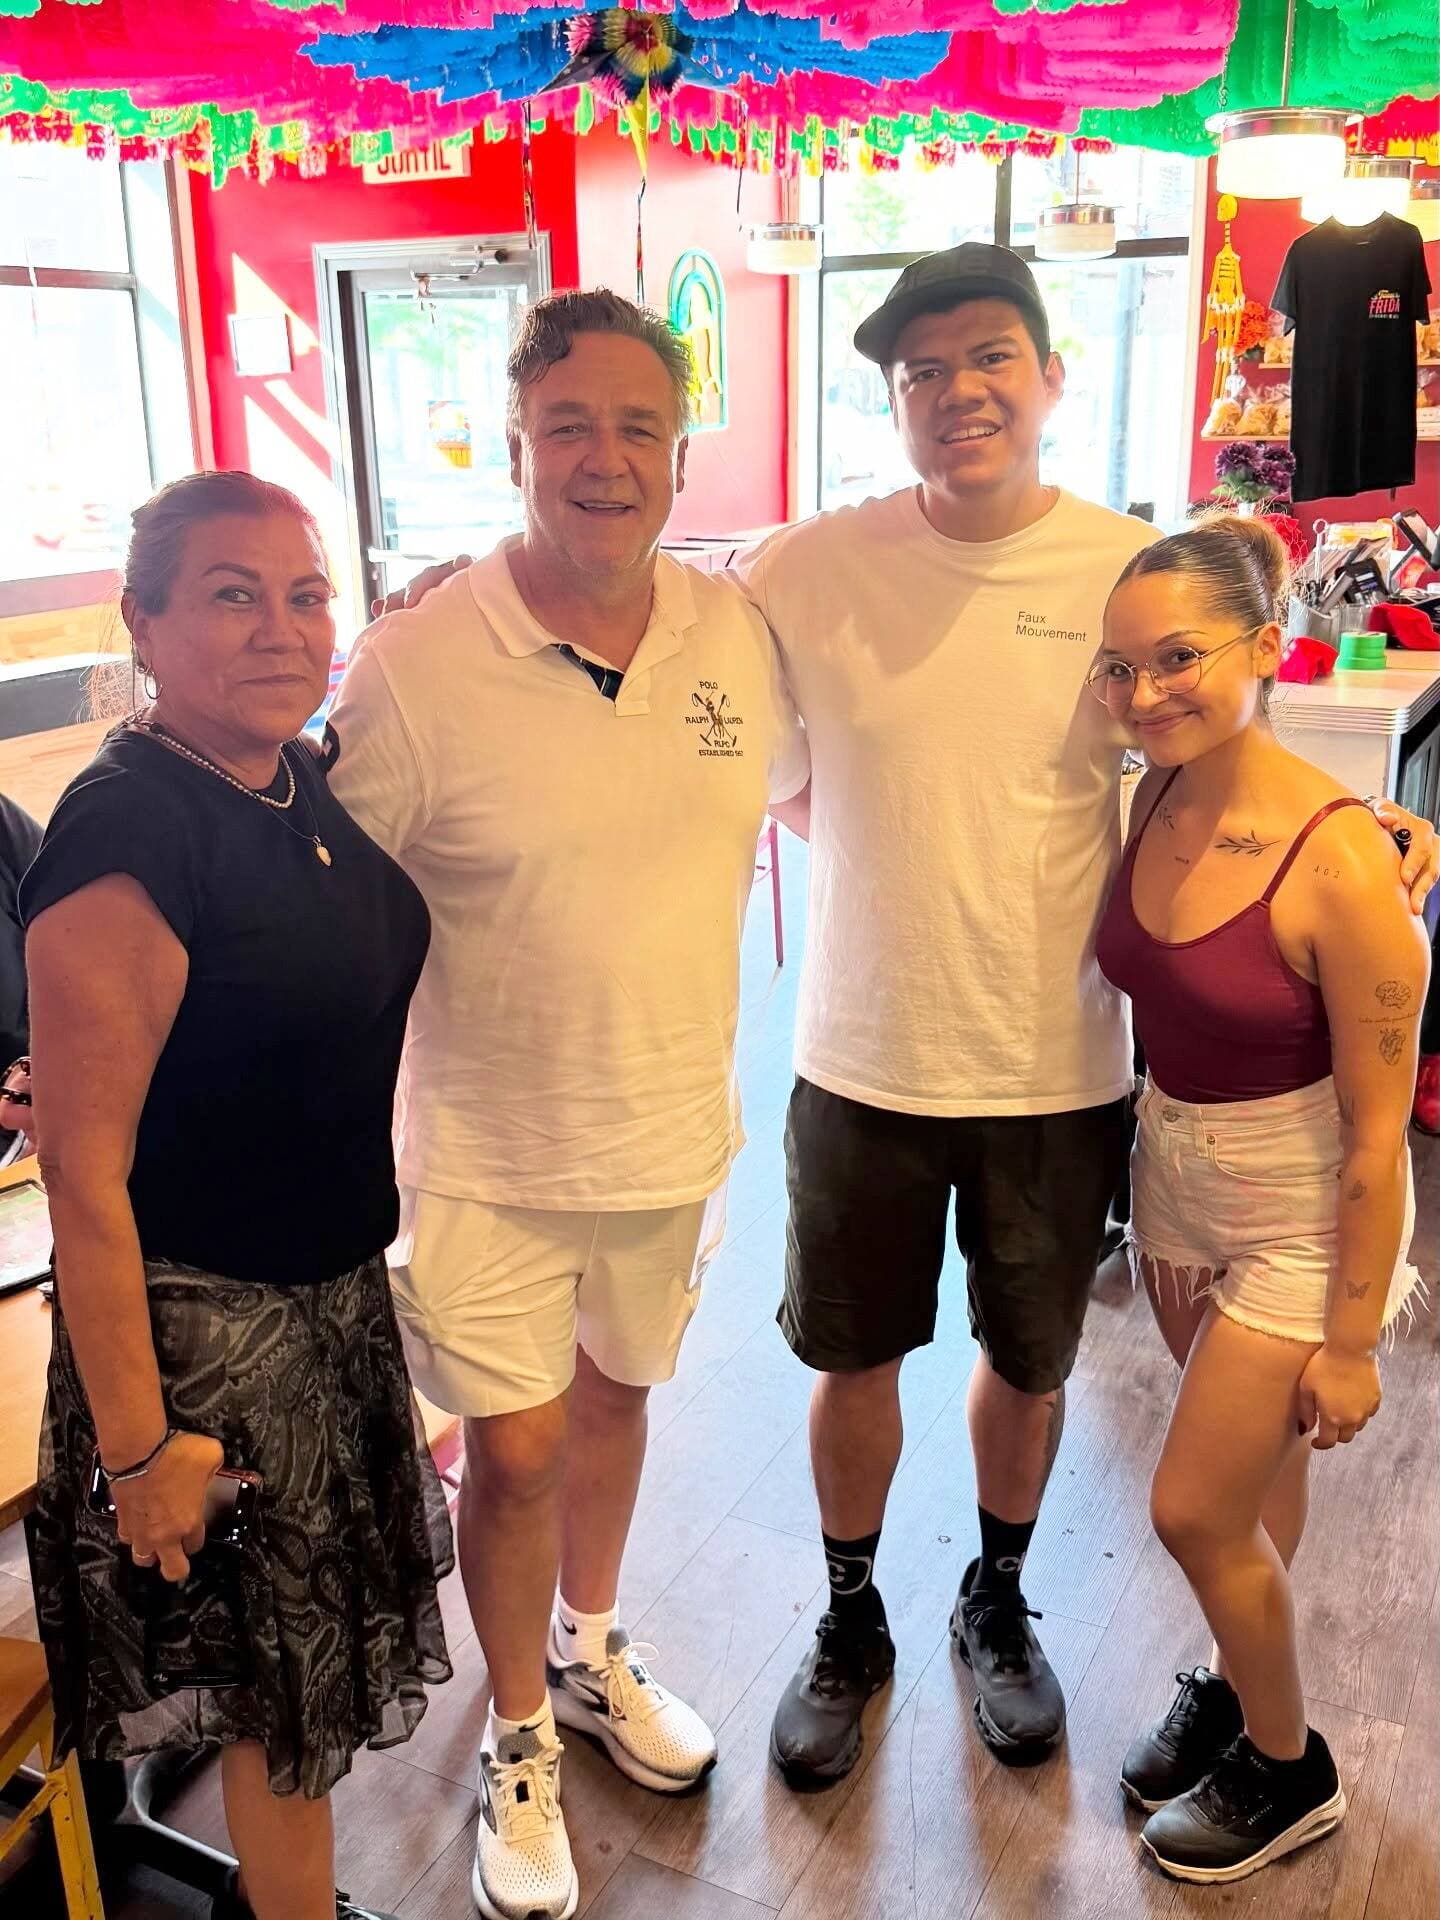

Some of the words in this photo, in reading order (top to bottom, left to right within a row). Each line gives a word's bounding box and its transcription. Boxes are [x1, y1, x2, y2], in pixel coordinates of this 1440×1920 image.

[1370, 298, 1400, 314] FRIDA
[1017, 611, 1047, 624] Faux
[1015, 624, 1088, 642] Mouvement
[699, 681, 719, 690] POLO
[685, 716, 710, 724] RALPH
